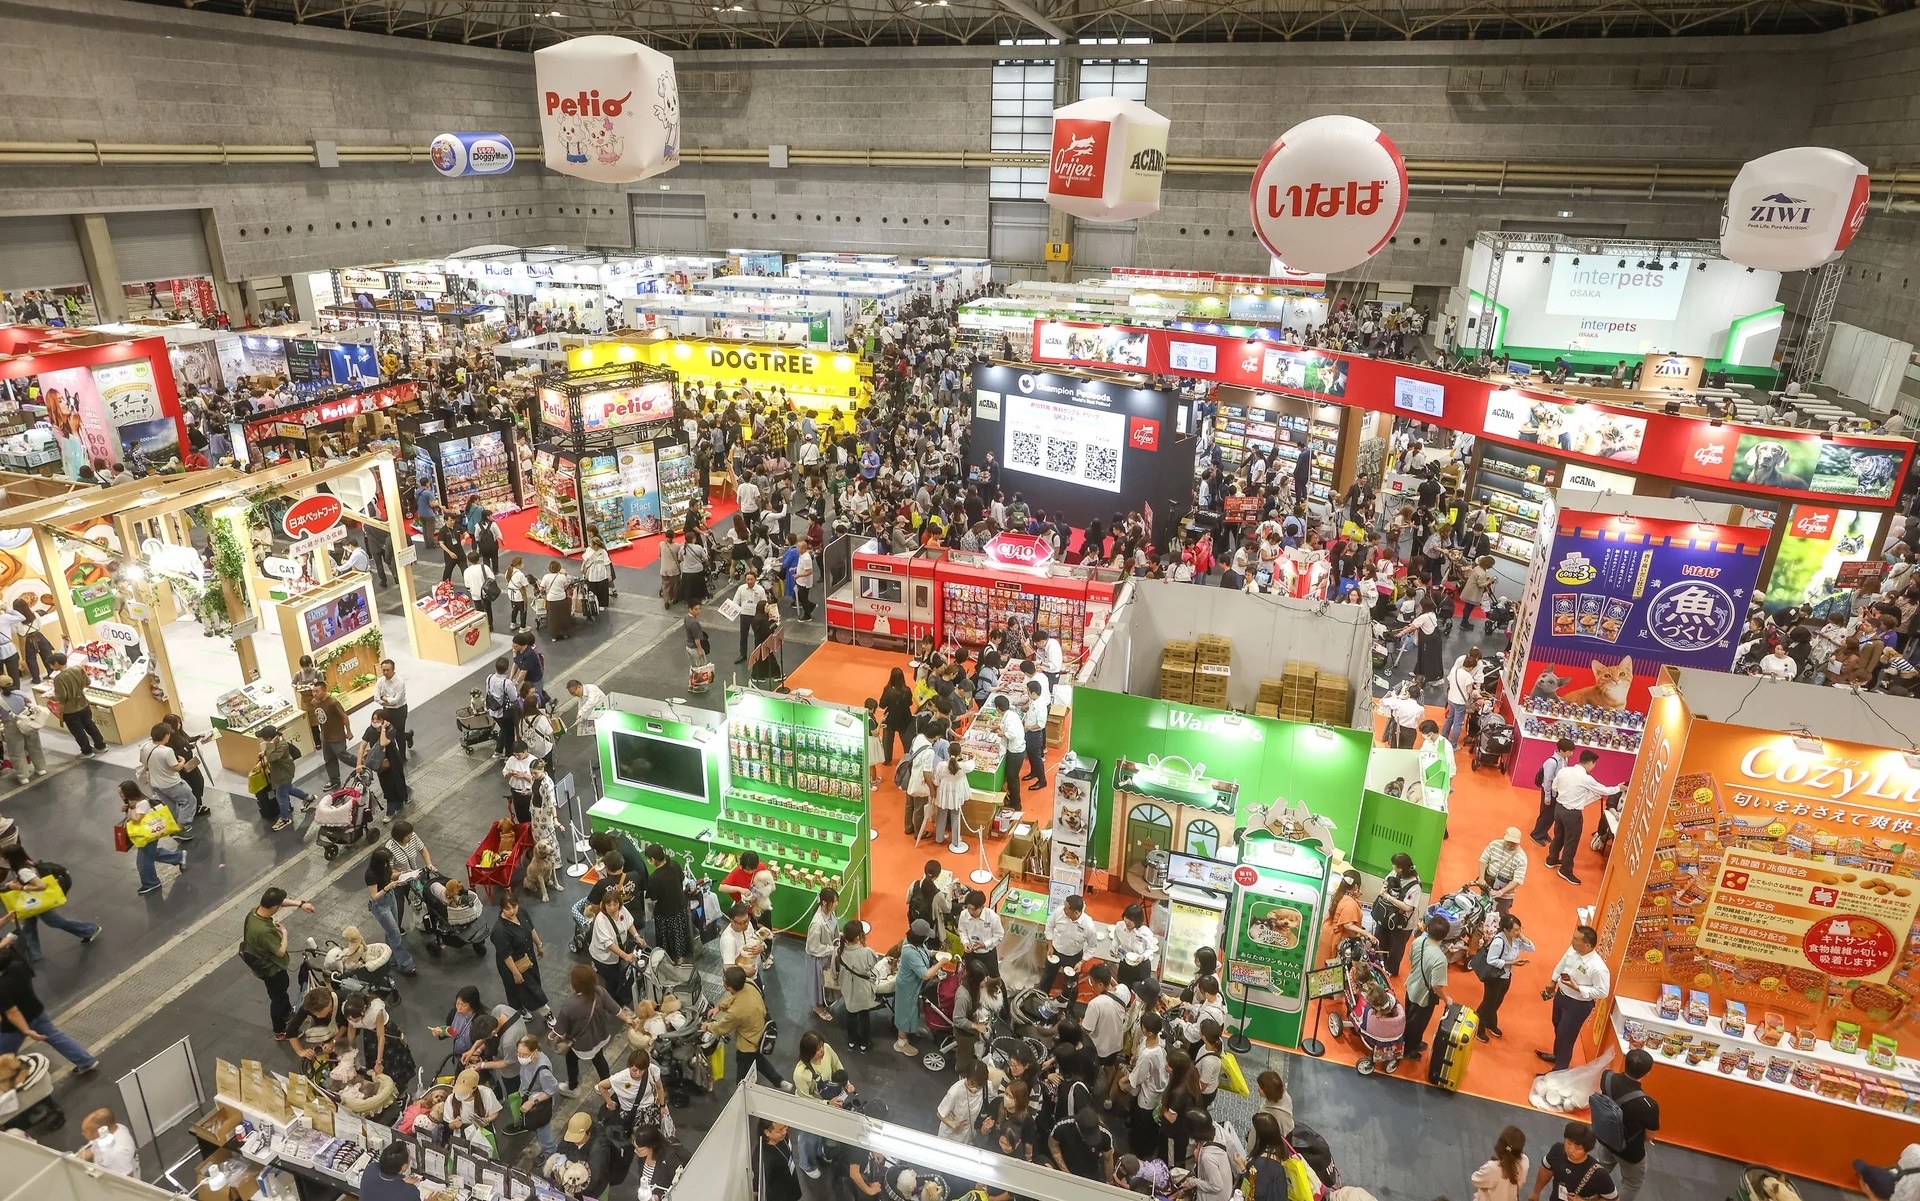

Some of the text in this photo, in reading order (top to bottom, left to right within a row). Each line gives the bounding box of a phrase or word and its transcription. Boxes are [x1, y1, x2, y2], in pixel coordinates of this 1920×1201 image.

[546, 90, 632, 117] Petio
[473, 152, 508, 162] DoggyMan
[1130, 148, 1166, 173] ACAN
[1268, 180, 1388, 219] いなば
[1750, 206, 1811, 223] ZIWI
[1573, 267, 1664, 289] interpets
[1570, 289, 1601, 298] OSAKA
[1581, 318, 1637, 333] interpets
[1654, 365, 1691, 377] ZIWI
[321, 400, 358, 420] Petio
[543, 400, 567, 418] Petio
[603, 395, 657, 418] Petio
[979, 398, 998, 411] ACANA
[1491, 408, 1515, 420] ACANA
[1569, 475, 1596, 488] ACANA
[630, 502, 651, 513] Plact
[289, 503, 339, 529] 日本ペットフード
[998, 543, 1035, 558] CIAO
[279, 564, 296, 575] CAT
[1682, 564, 1721, 578] いなば
[870, 603, 892, 612] CIAO
[1664, 585, 1716, 626] 魚
[308, 607, 328, 622] Pure
[111, 629, 132, 641] DOG
[1637, 629, 1648, 638] 足
[1662, 624, 1711, 641] づくし
[337, 658, 358, 675] Pure
[1673, 805, 1713, 817] CozyLife
[1738, 826, 1768, 834] CozyLife
[1730, 856, 1808, 878] 乳酸菌1兆個配合
[1719, 894, 1775, 911] キトサン配合
[1709, 921, 1788, 943] 緑茶消臭成分配合
[1821, 934, 1877, 946] キトサンの
[1808, 943, 1889, 958] 食物繊維が匂いを
[1240, 951, 1300, 970] あなたのワンちゃんと
[1819, 955, 1877, 968] 吸着します。
